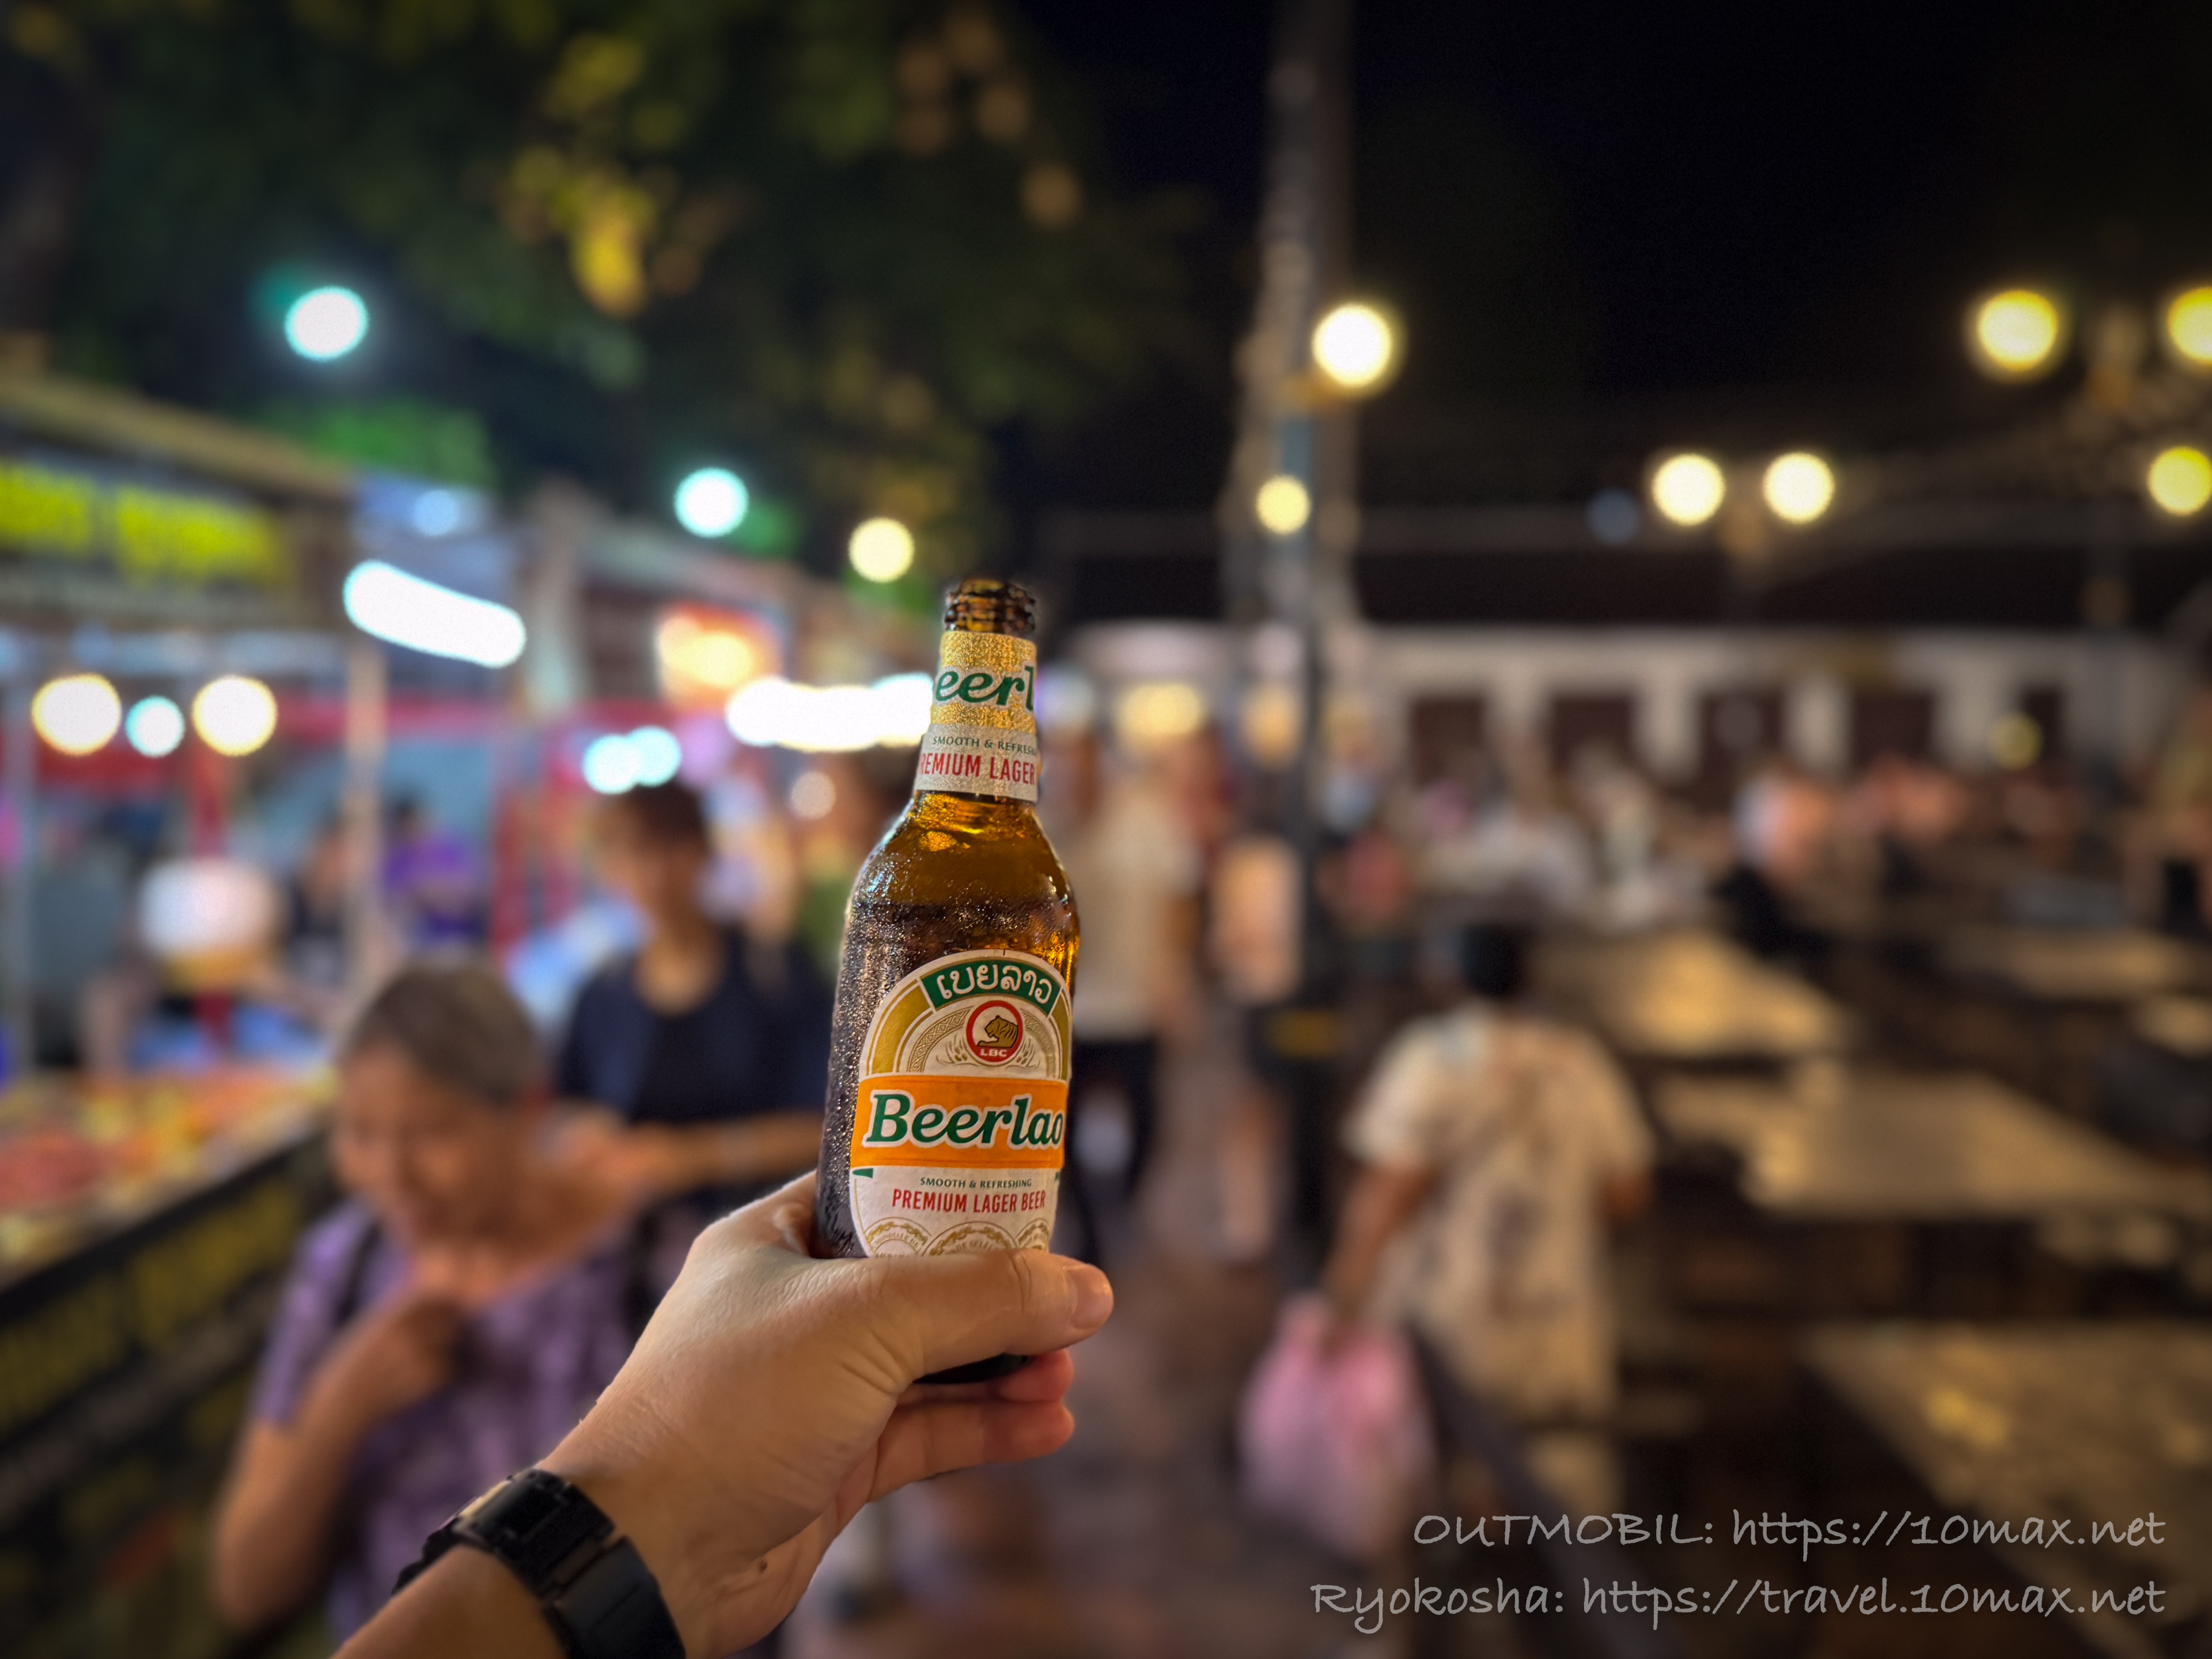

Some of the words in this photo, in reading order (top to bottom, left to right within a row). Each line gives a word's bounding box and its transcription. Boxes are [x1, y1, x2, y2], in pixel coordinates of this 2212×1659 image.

[933, 736, 980, 747] SMOOTH
[984, 739, 993, 748] &
[989, 756, 1035, 786] LAGER
[980, 1048, 1007, 1058] LBC
[865, 1093, 1064, 1145] Beerlao
[920, 1177, 966, 1188] SMOOTH
[969, 1180, 976, 1188] &
[980, 1178, 1032, 1188] REFRESHING
[892, 1188, 967, 1213] PREMIUM
[973, 1193, 1017, 1213] LAGER
[1021, 1190, 1046, 1211] BEER
